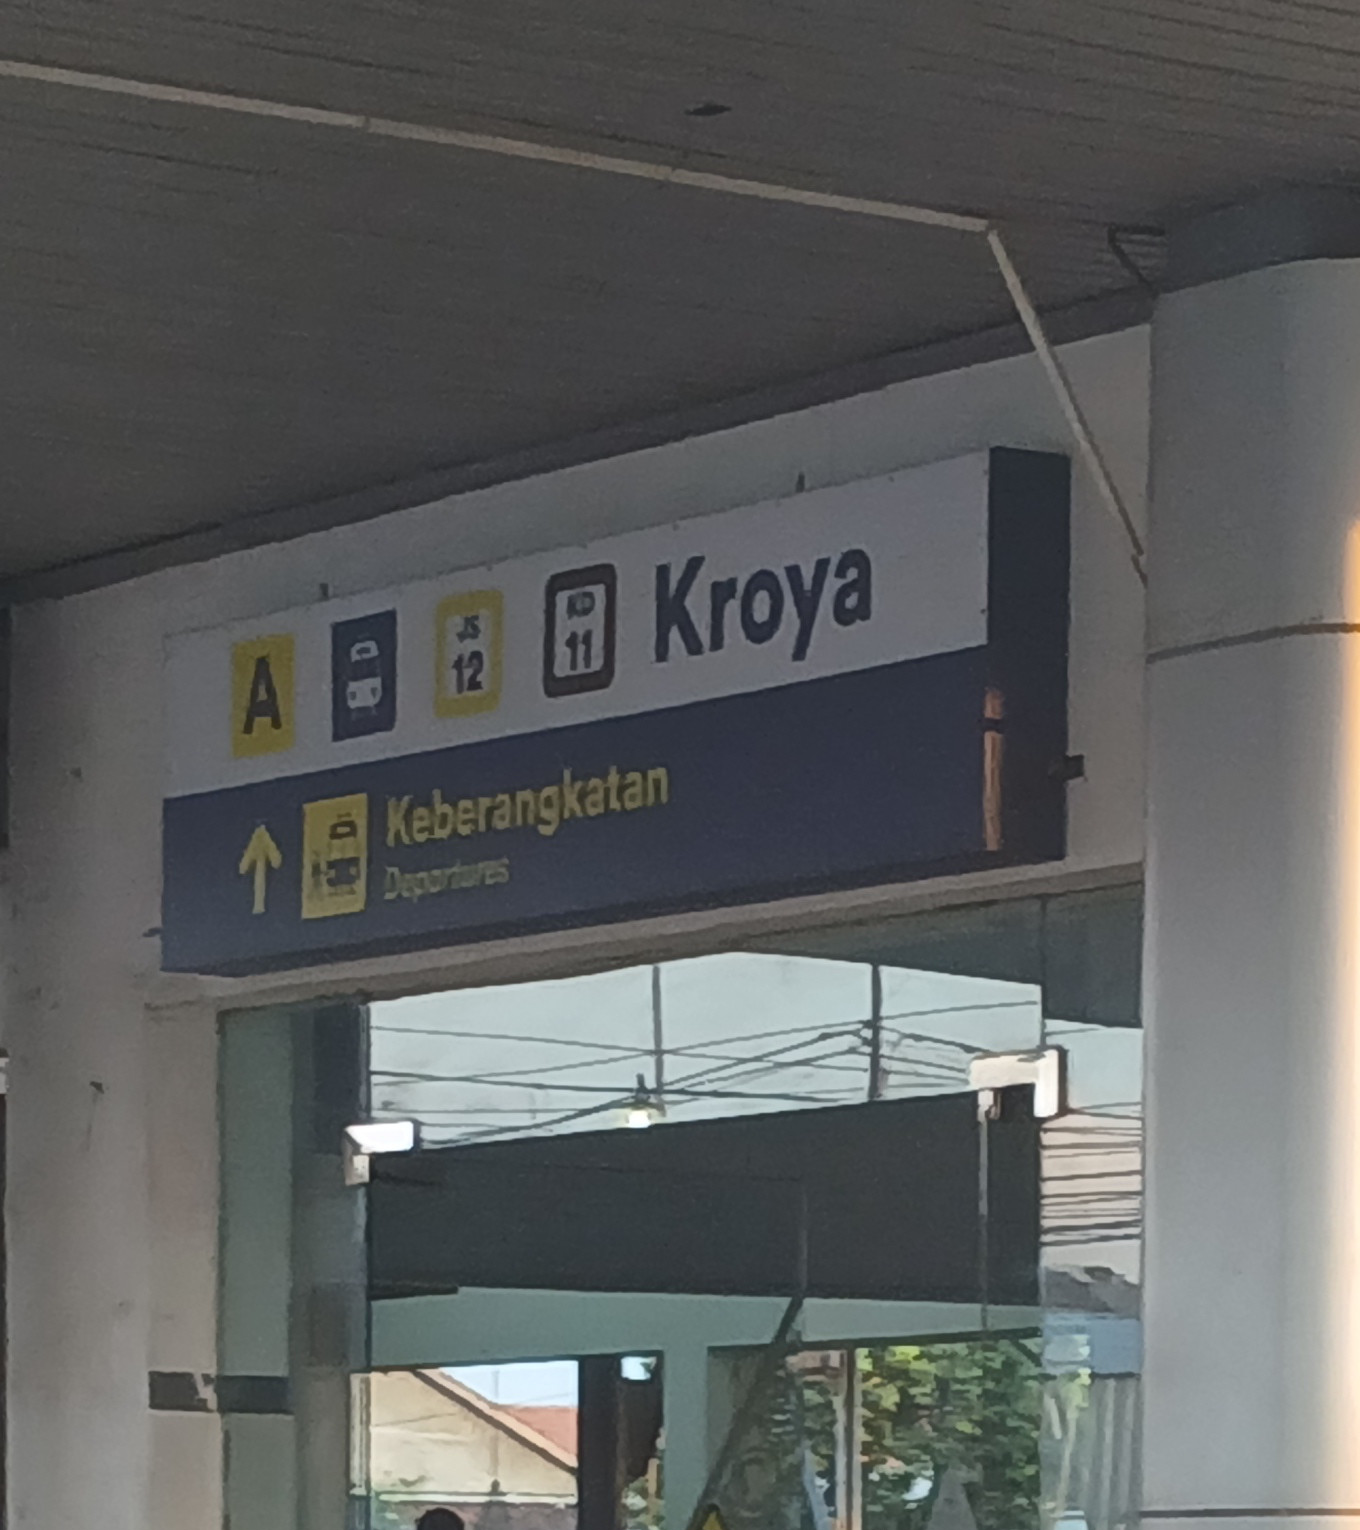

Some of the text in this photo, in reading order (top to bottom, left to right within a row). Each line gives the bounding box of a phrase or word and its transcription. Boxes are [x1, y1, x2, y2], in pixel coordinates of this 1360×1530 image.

[655, 549, 872, 663] Kroya
[451, 651, 484, 694] 12
[565, 629, 593, 671] 11
[243, 655, 282, 735] A
[386, 765, 669, 847] Keberangkatan
